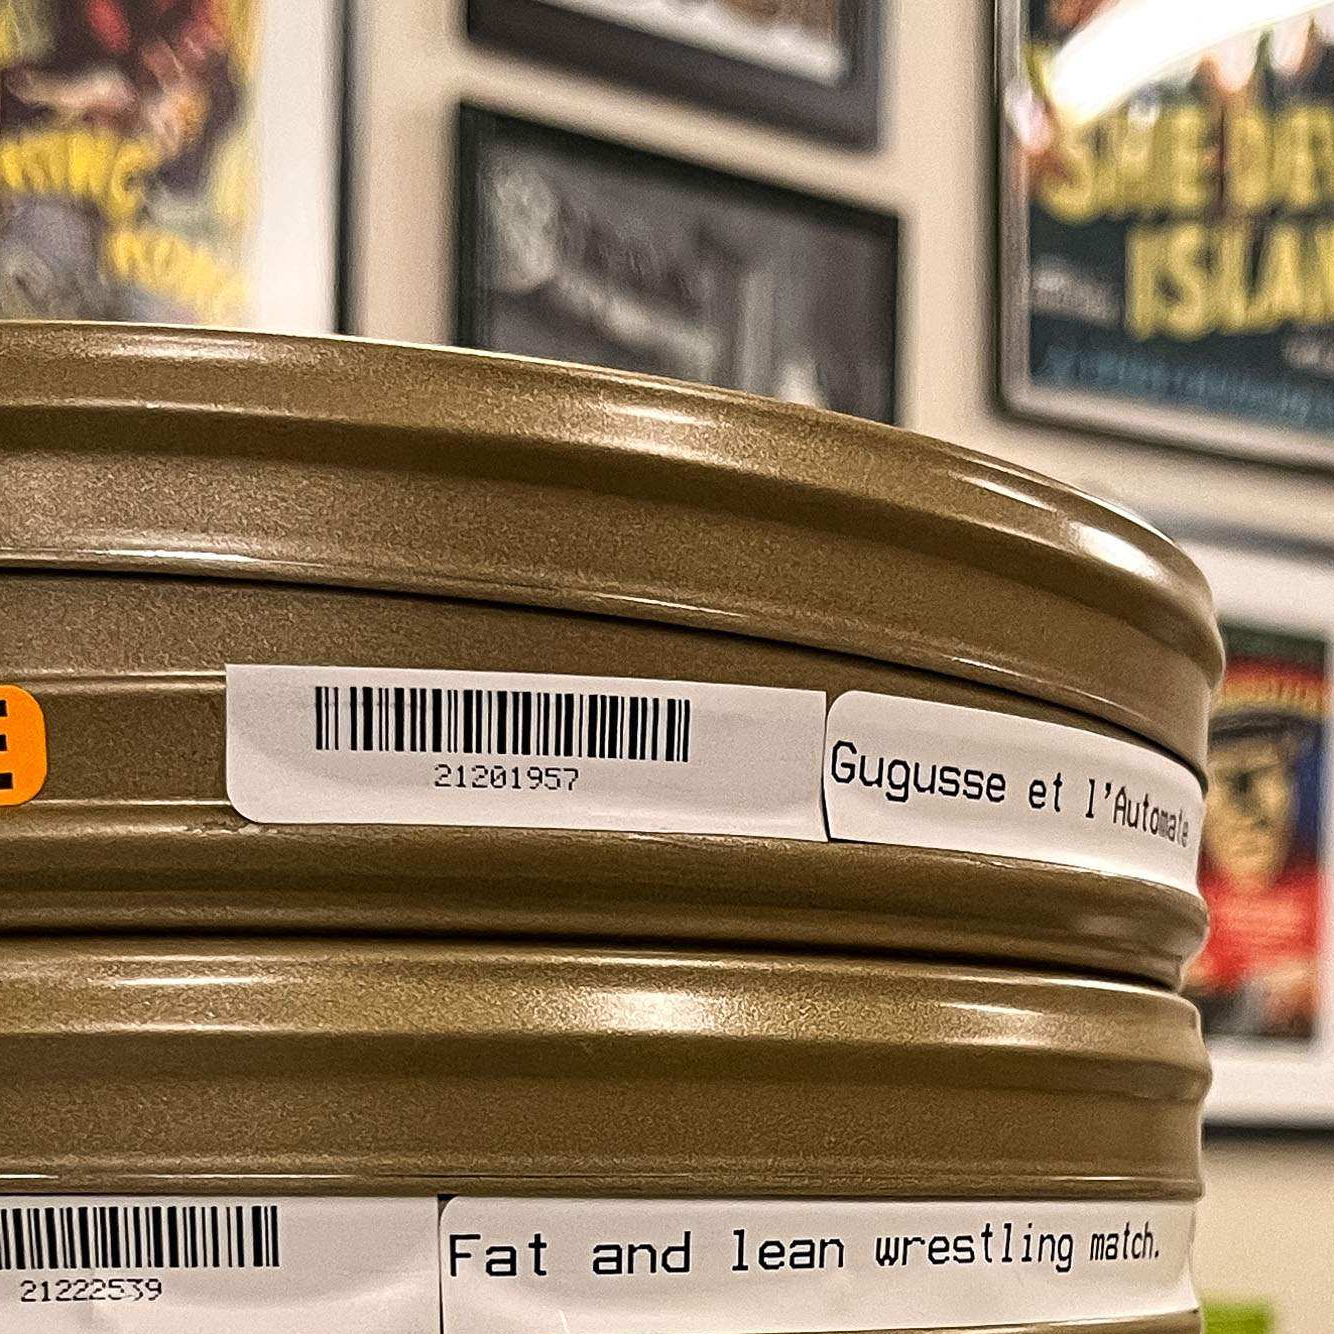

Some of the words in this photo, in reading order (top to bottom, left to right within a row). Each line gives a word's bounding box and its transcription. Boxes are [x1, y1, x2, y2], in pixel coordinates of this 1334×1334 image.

[434, 763, 581, 792] 21201957
[830, 740, 1006, 802] Gugusse
[1028, 772, 1063, 812] et
[449, 1232, 548, 1277] Fat
[592, 1230, 692, 1275] and
[732, 1229, 845, 1272] lean
[874, 1222, 1074, 1273] wrestling
[1089, 1220, 1161, 1262] match.
[20, 1278, 163, 1303] 21222539
